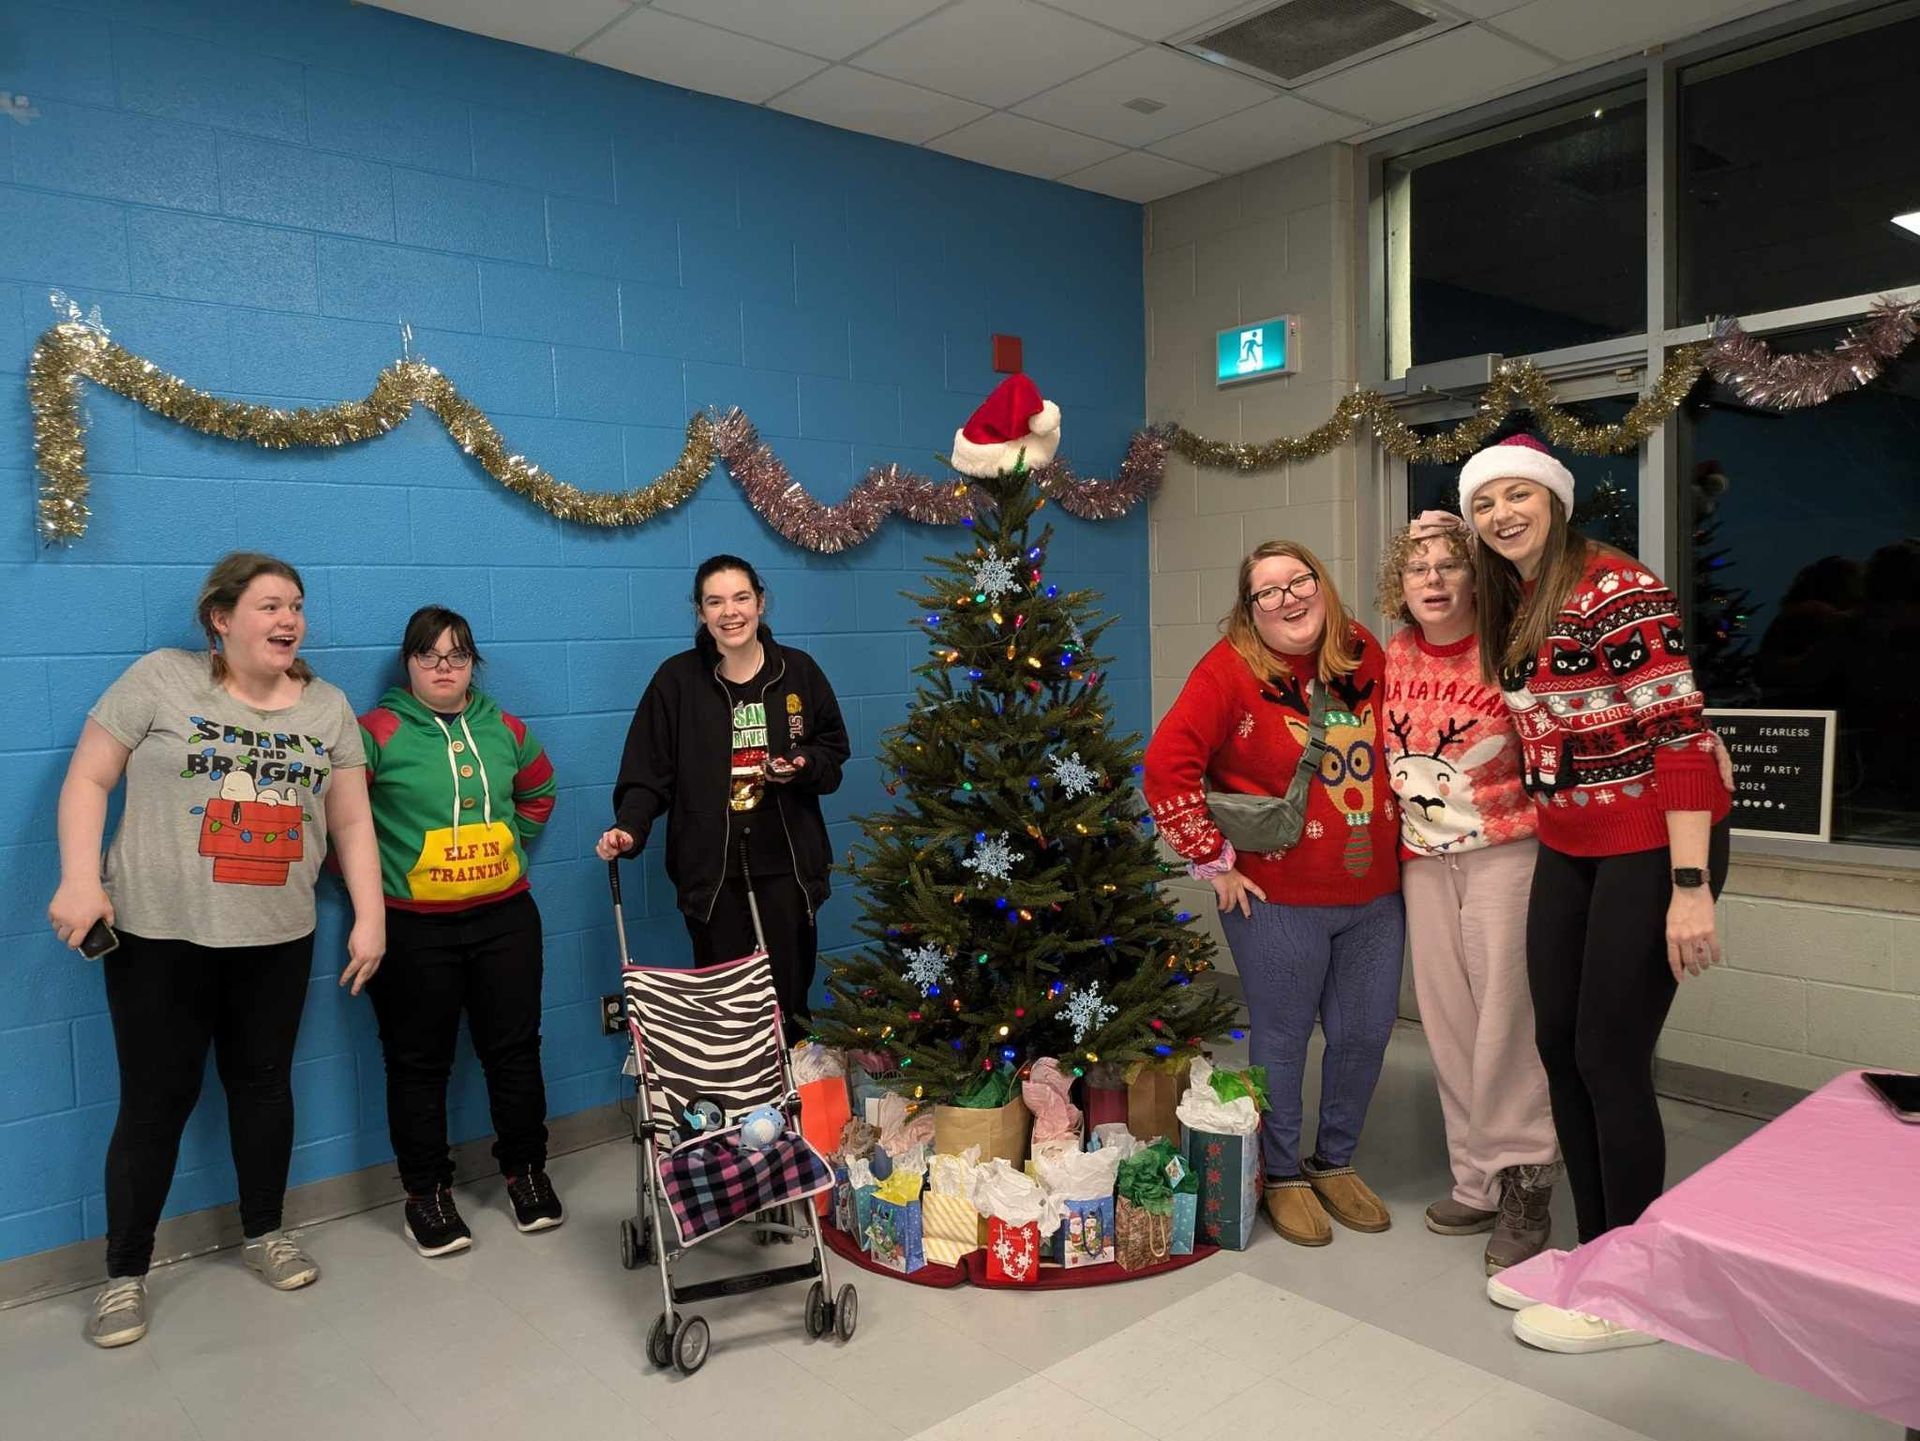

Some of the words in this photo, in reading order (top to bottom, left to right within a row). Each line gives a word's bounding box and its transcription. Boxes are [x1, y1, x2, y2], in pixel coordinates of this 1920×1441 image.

[1716, 726, 1737, 735] FUN
[1759, 727, 1810, 737] FEARLESS
[248, 747, 287, 760] AND
[1731, 744, 1778, 754] FEMALES
[1763, 765, 1801, 775] PARTY
[1739, 782, 1767, 791] 2024
[444, 844, 479, 862] ELF
[482, 841, 500, 857] IN
[429, 858, 510, 883] TRAINING
